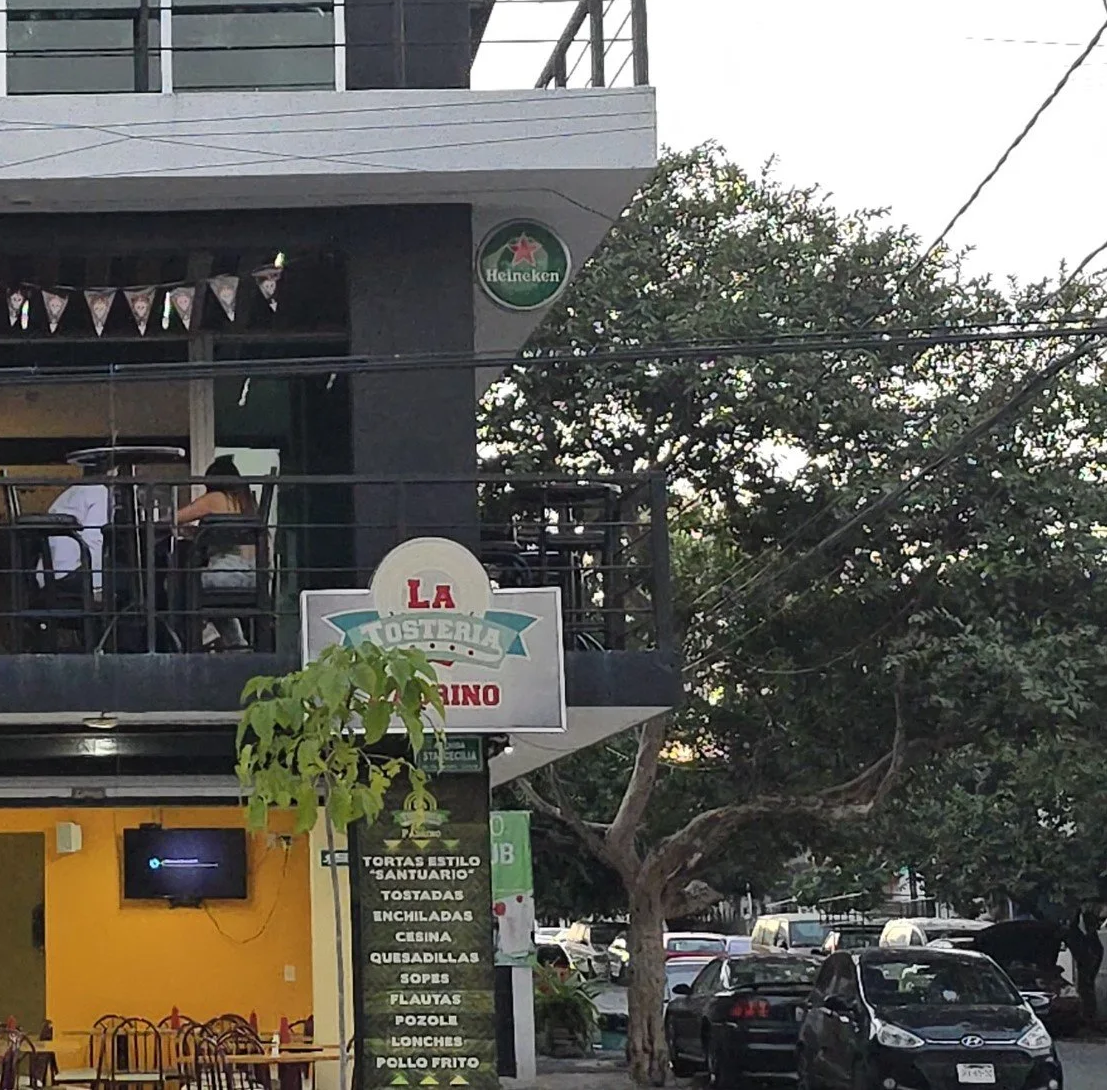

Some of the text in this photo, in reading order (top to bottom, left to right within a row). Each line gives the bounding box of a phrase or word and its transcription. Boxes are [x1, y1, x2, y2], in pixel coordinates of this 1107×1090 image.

[486, 269, 560, 283] Heineken
[407, 579, 456, 609] LA
[360, 617, 502, 649] TOSTERIA
[362, 856, 424, 867] TORTAS
[428, 856, 481, 867] ESTILO
[380, 890, 464, 901] TOSTADAS
[373, 910, 473, 922] ENCHILADAS
[395, 931, 452, 942] CESINA
[370, 952, 480, 964] QUESADILLAS
[400, 973, 450, 984] SOPES
[390, 994, 462, 1005] FLAUTAS
[395, 1015, 458, 1026] POZOLE
[391, 1036, 463, 1047] LONCHES
[376, 1057, 480, 1068] POLLO FRITO
